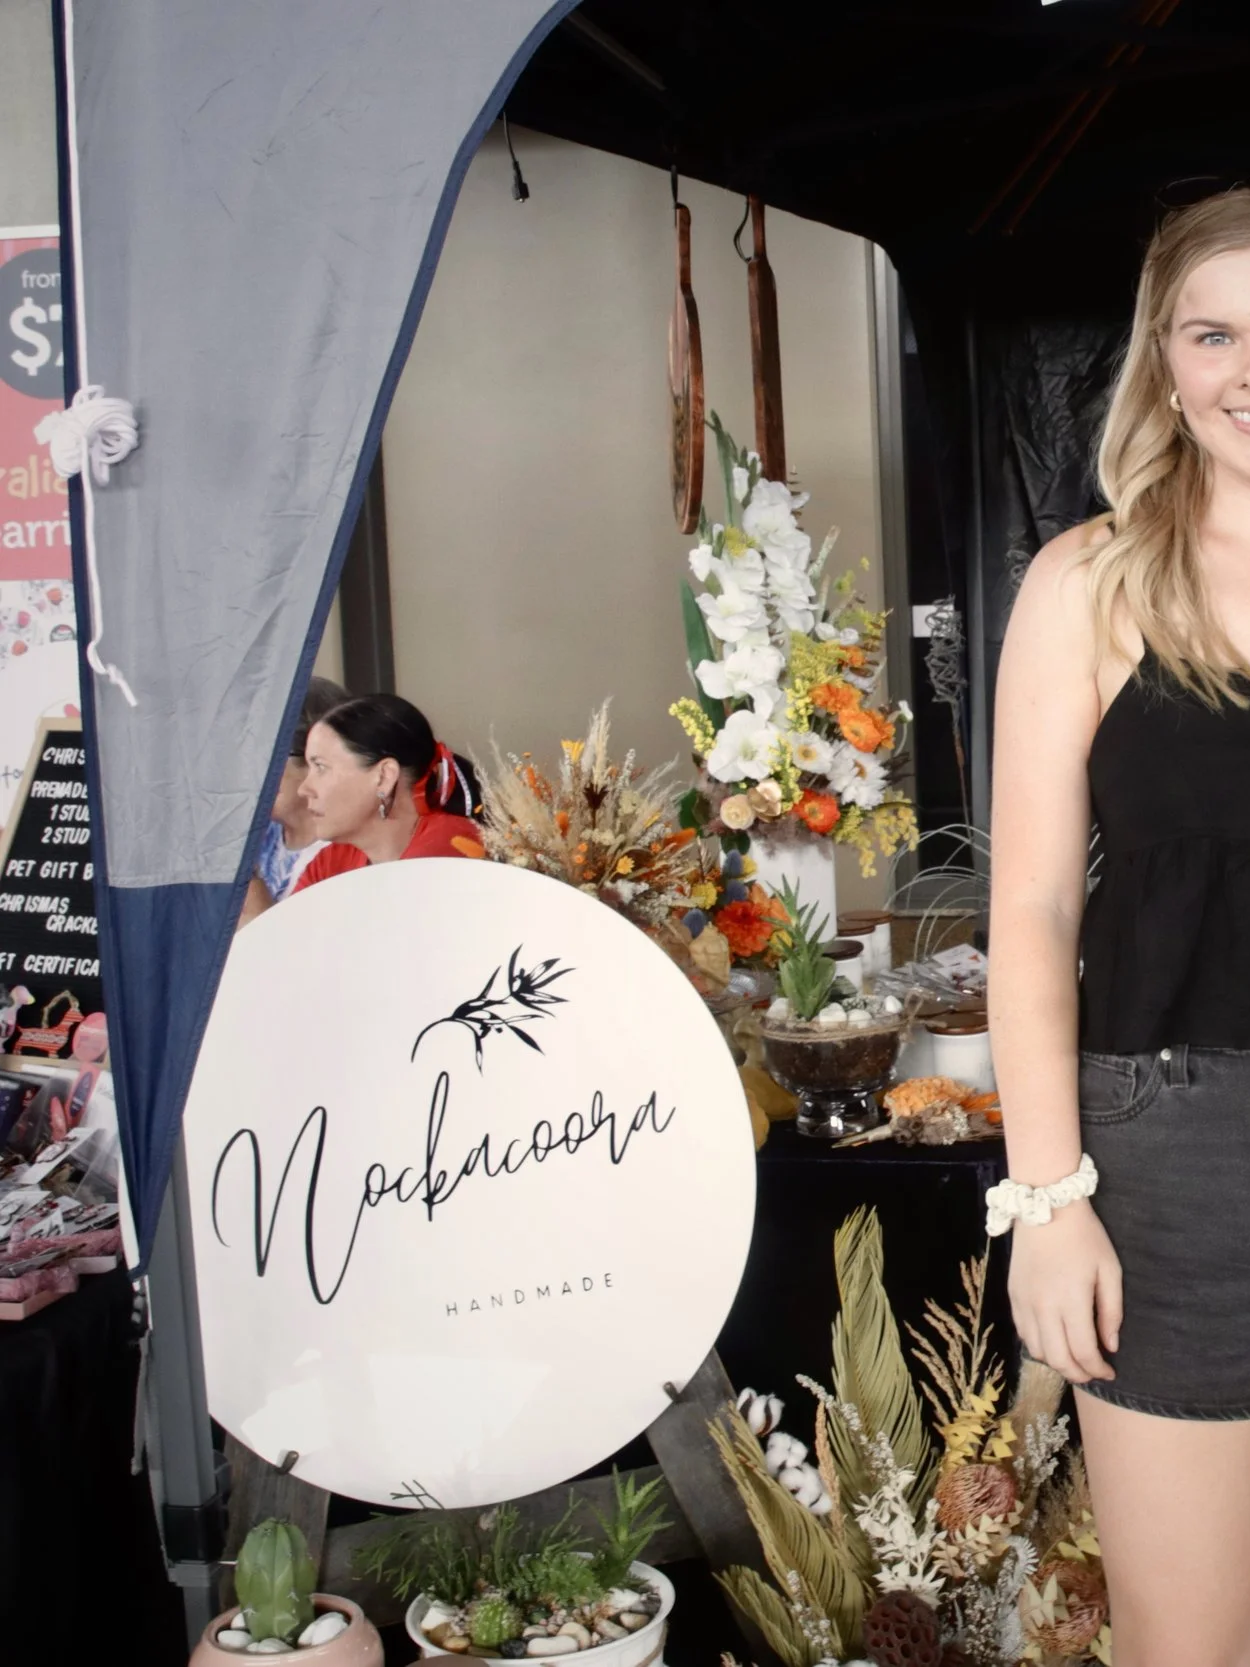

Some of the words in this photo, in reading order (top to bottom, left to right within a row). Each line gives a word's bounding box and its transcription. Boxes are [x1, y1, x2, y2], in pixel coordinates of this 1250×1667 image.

[0, 453, 69, 500] ali
[0, 509, 72, 549] arri
[41, 825, 54, 844] 2
[5, 859, 37, 878] PET
[39, 860, 79, 880] GIFT
[445, 1272, 615, 1317] HANDMADE
